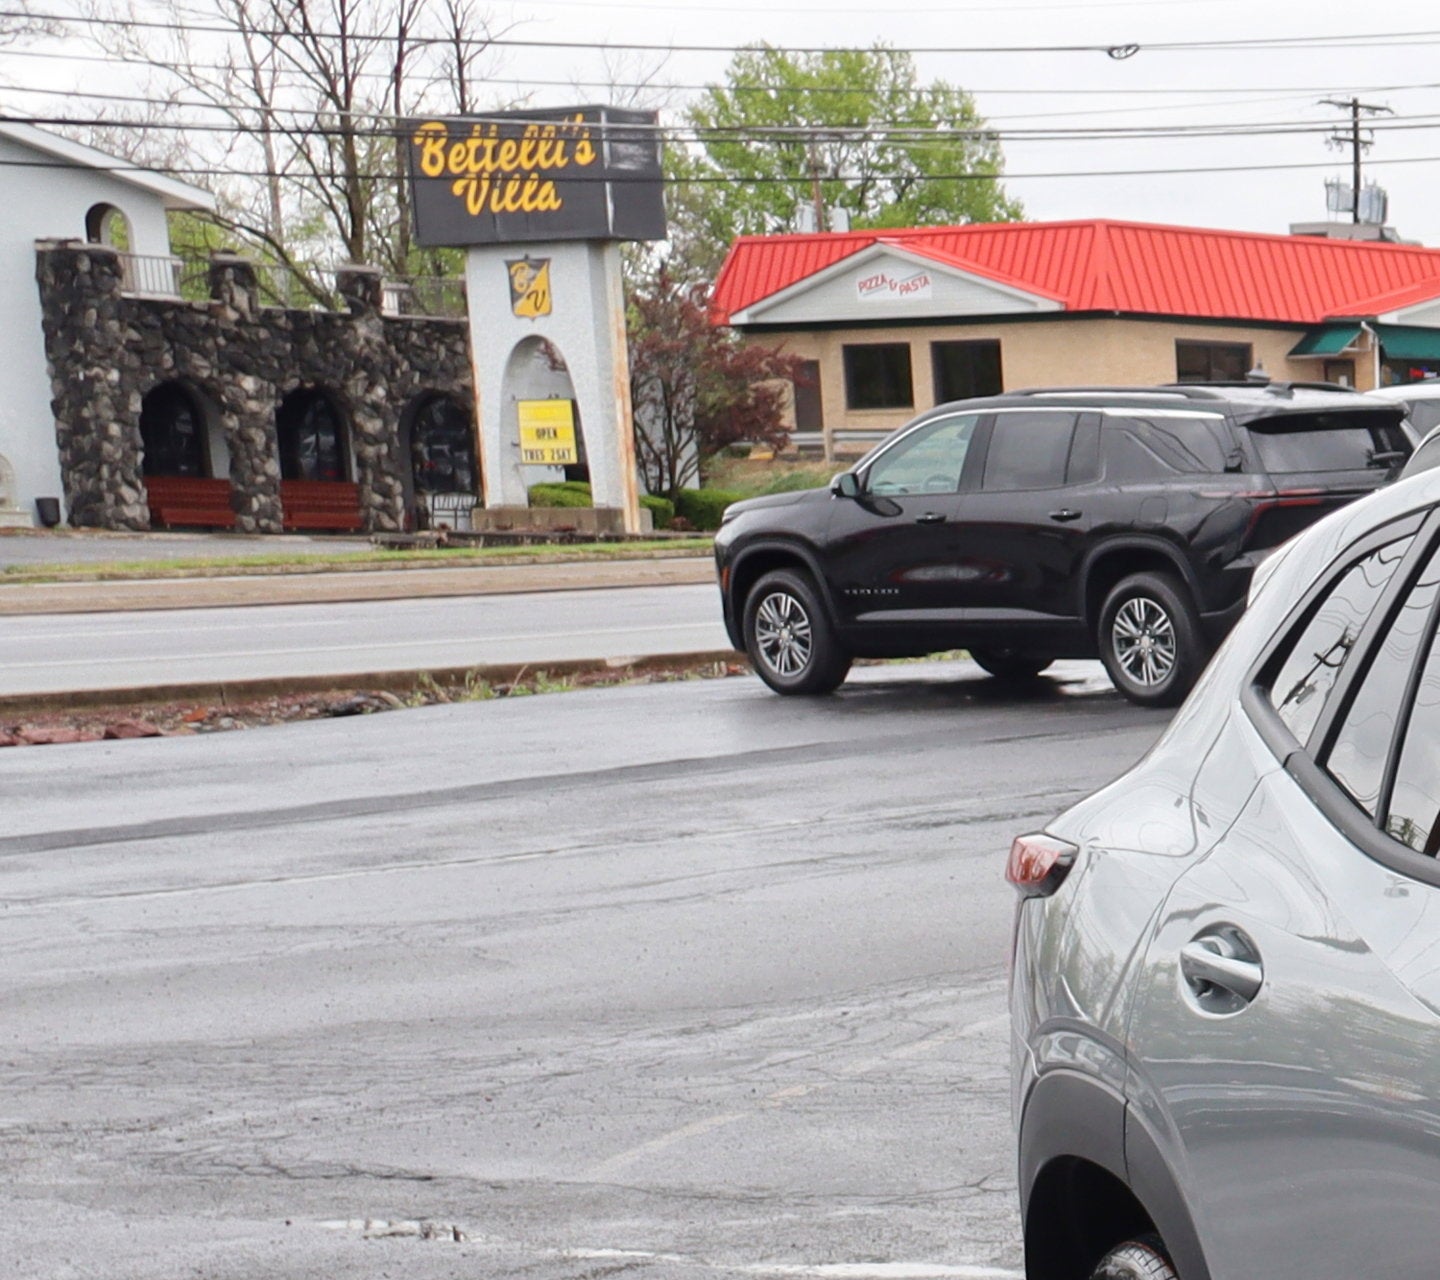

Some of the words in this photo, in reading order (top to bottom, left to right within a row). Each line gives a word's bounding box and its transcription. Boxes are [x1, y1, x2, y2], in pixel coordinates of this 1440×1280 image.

[413, 113, 596, 177] Bettelli's
[452, 172, 563, 216] Villa
[858, 273, 887, 293] PIZZA
[899, 275, 930, 295] PASTA
[535, 427, 558, 440] OPEN
